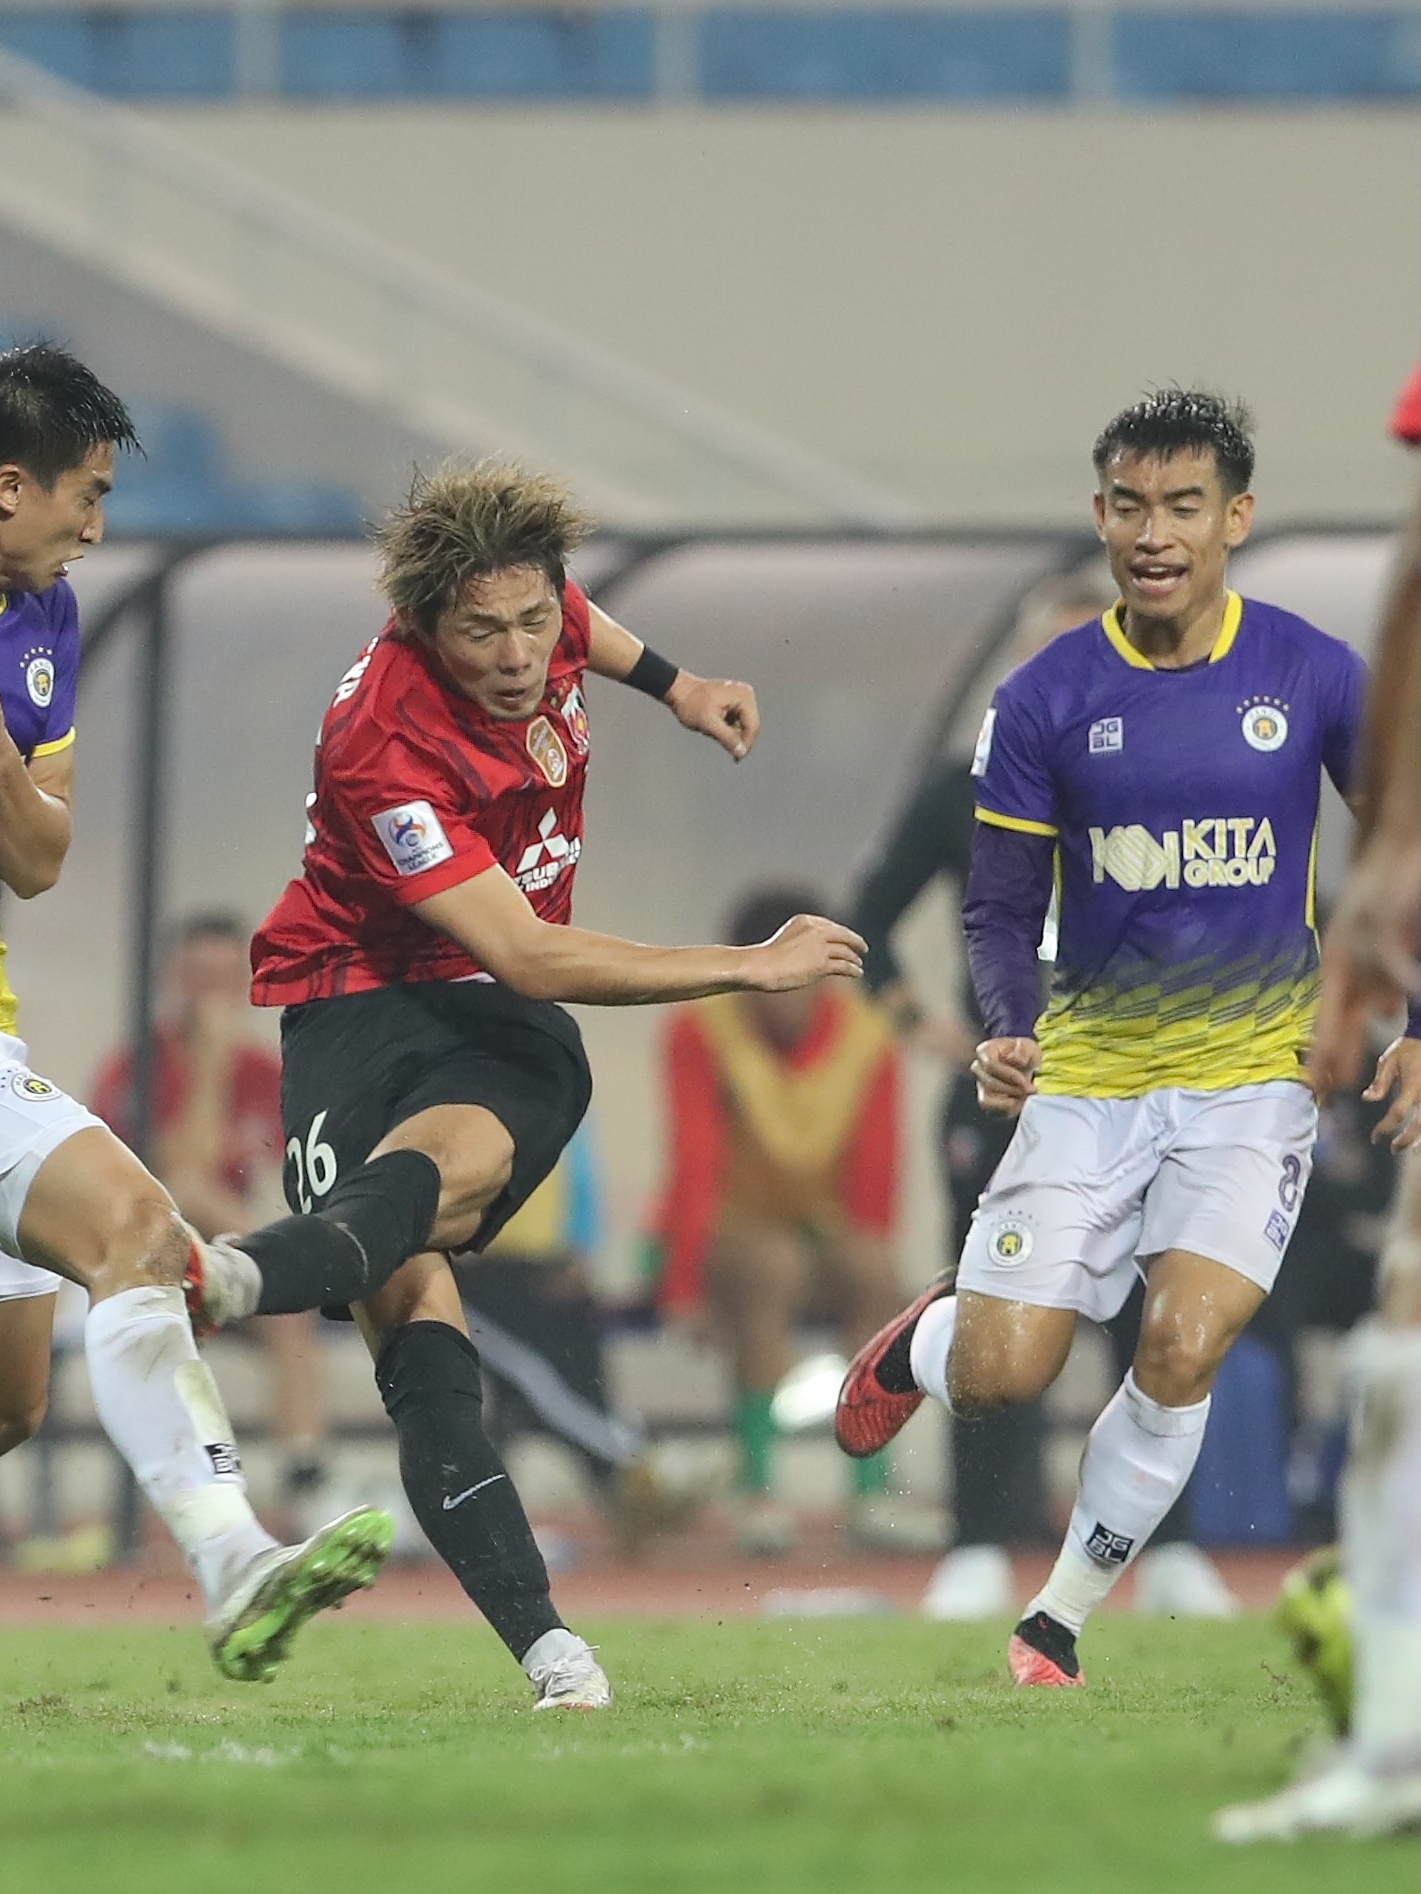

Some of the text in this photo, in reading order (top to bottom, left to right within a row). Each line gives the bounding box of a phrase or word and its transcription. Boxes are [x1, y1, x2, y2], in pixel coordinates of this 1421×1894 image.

[1182, 817, 1278, 861] KITA
[1183, 856, 1277, 889] GROUP
[286, 1109, 337, 1216] 26
[1278, 1153, 1301, 1213] 8
